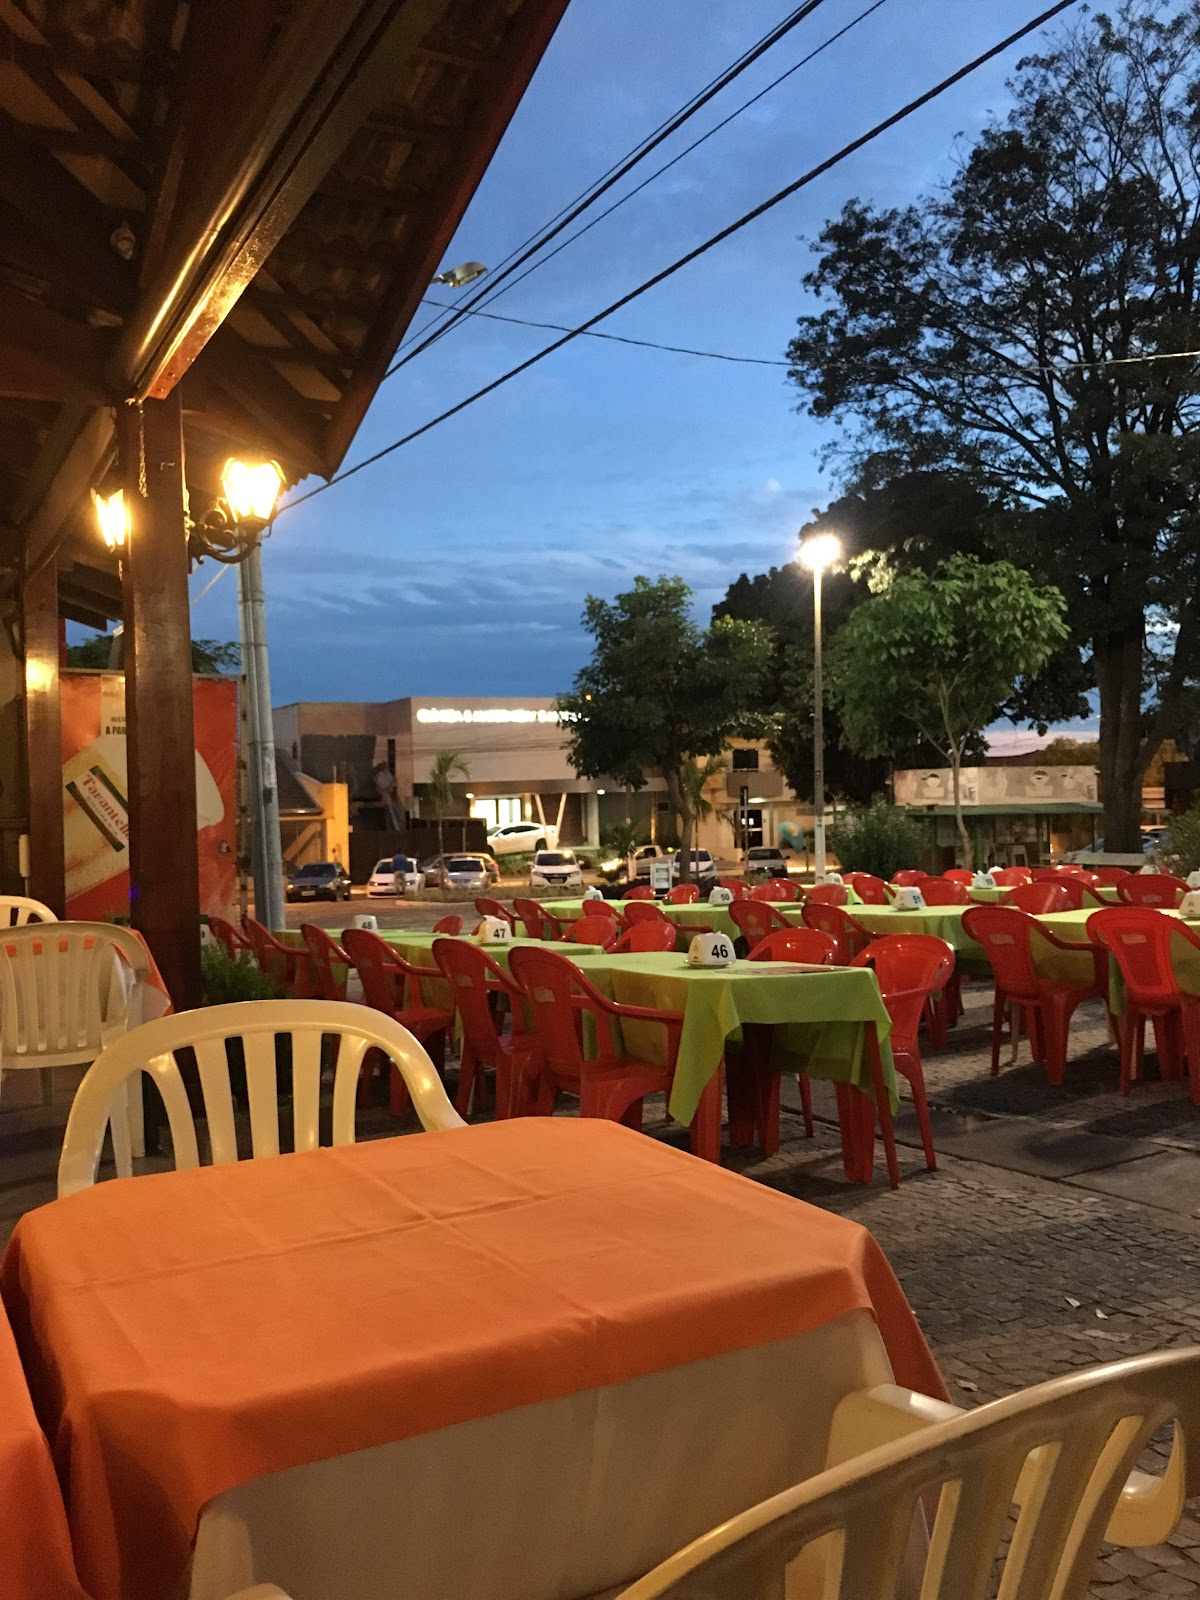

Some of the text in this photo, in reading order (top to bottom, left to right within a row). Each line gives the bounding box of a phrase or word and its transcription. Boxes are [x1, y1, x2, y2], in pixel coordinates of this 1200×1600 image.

[106, 726, 111, 735] A
[83, 775, 129, 838] Tarantell
[720, 893, 730, 901] 50
[912, 895, 922, 904] 51
[361, 921, 373, 930] 48
[493, 928, 506, 939] 47
[711, 944, 729, 959] 46
